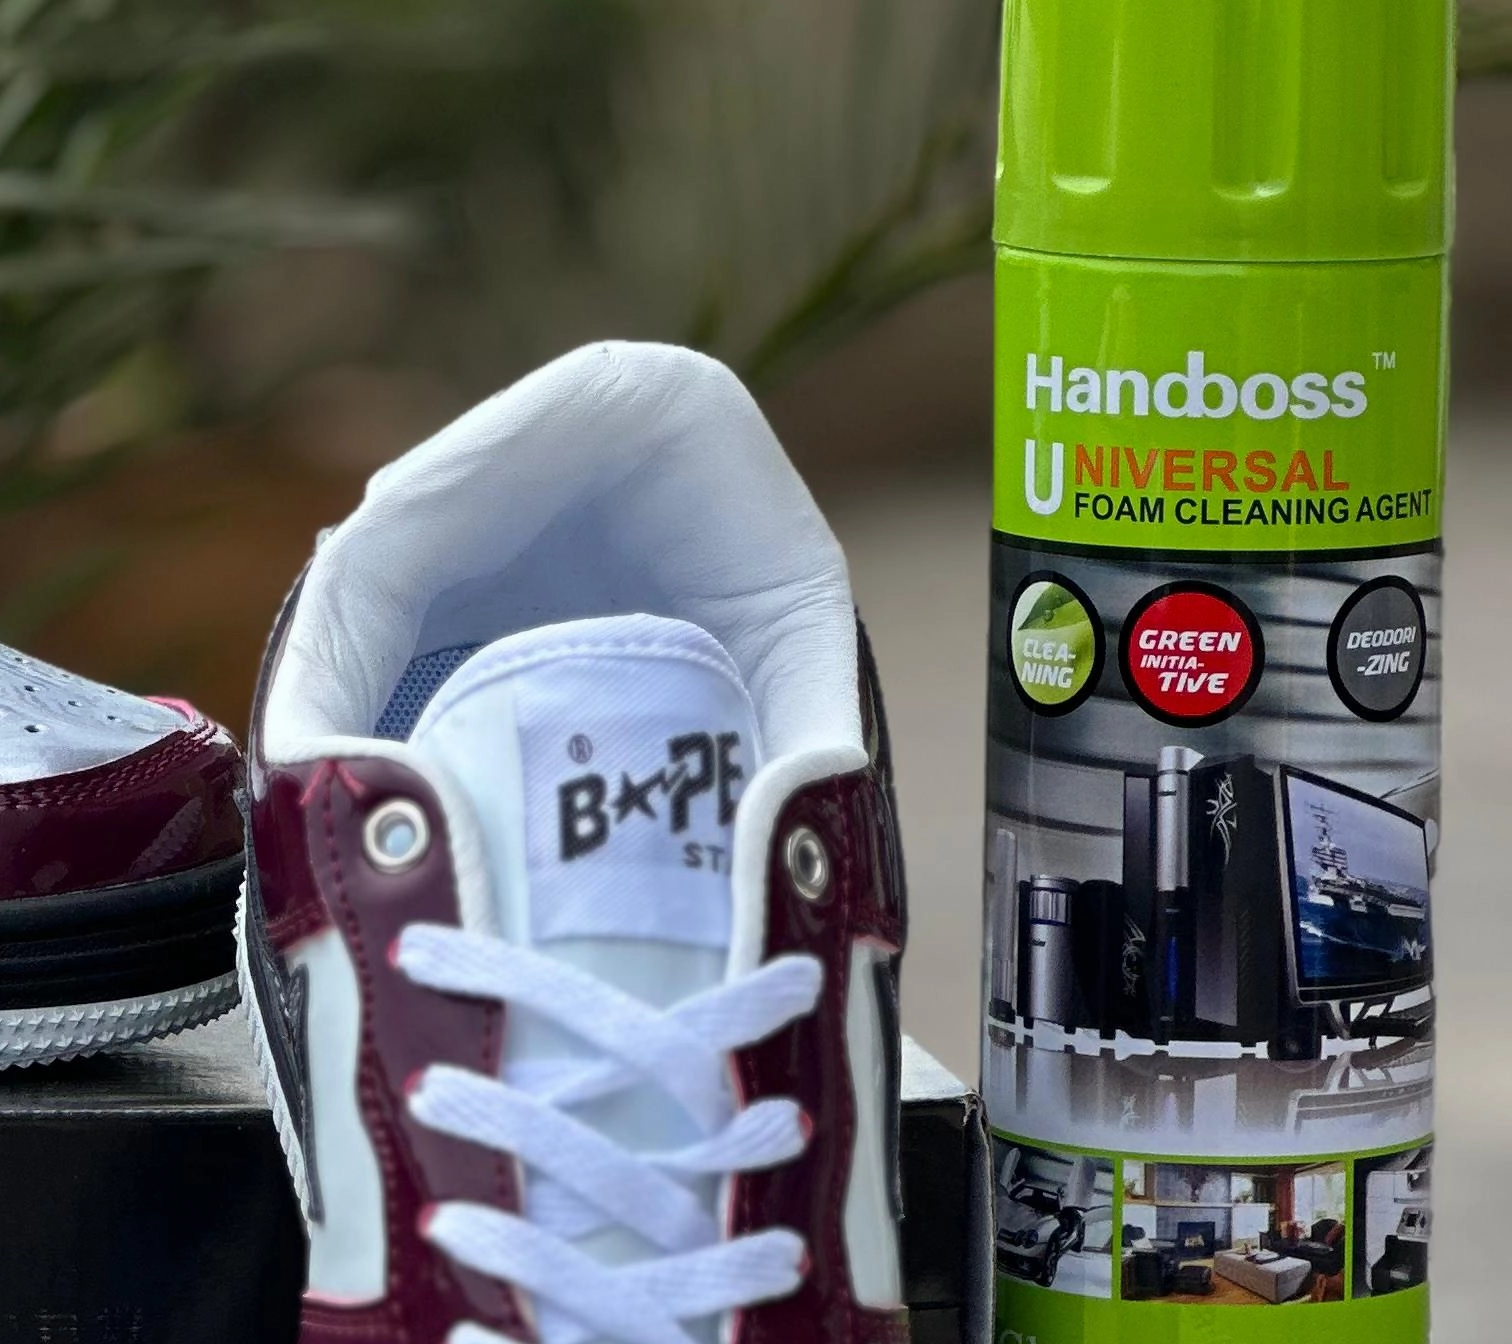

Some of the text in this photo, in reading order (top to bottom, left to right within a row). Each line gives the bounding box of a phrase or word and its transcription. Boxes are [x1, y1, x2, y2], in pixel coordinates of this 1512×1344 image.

[1026, 351, 1368, 420] Handboss
[1075, 488, 1433, 526] FOAM CLEANING AGENT
[1139, 629, 1242, 652] GREEN
[1346, 626, 1416, 649] DEODORI
[1022, 638, 1076, 662] CLEA-
[1140, 654, 1205, 670] INITIA-
[1021, 661, 1074, 689] NING
[1158, 671, 1229, 694] TIVE
